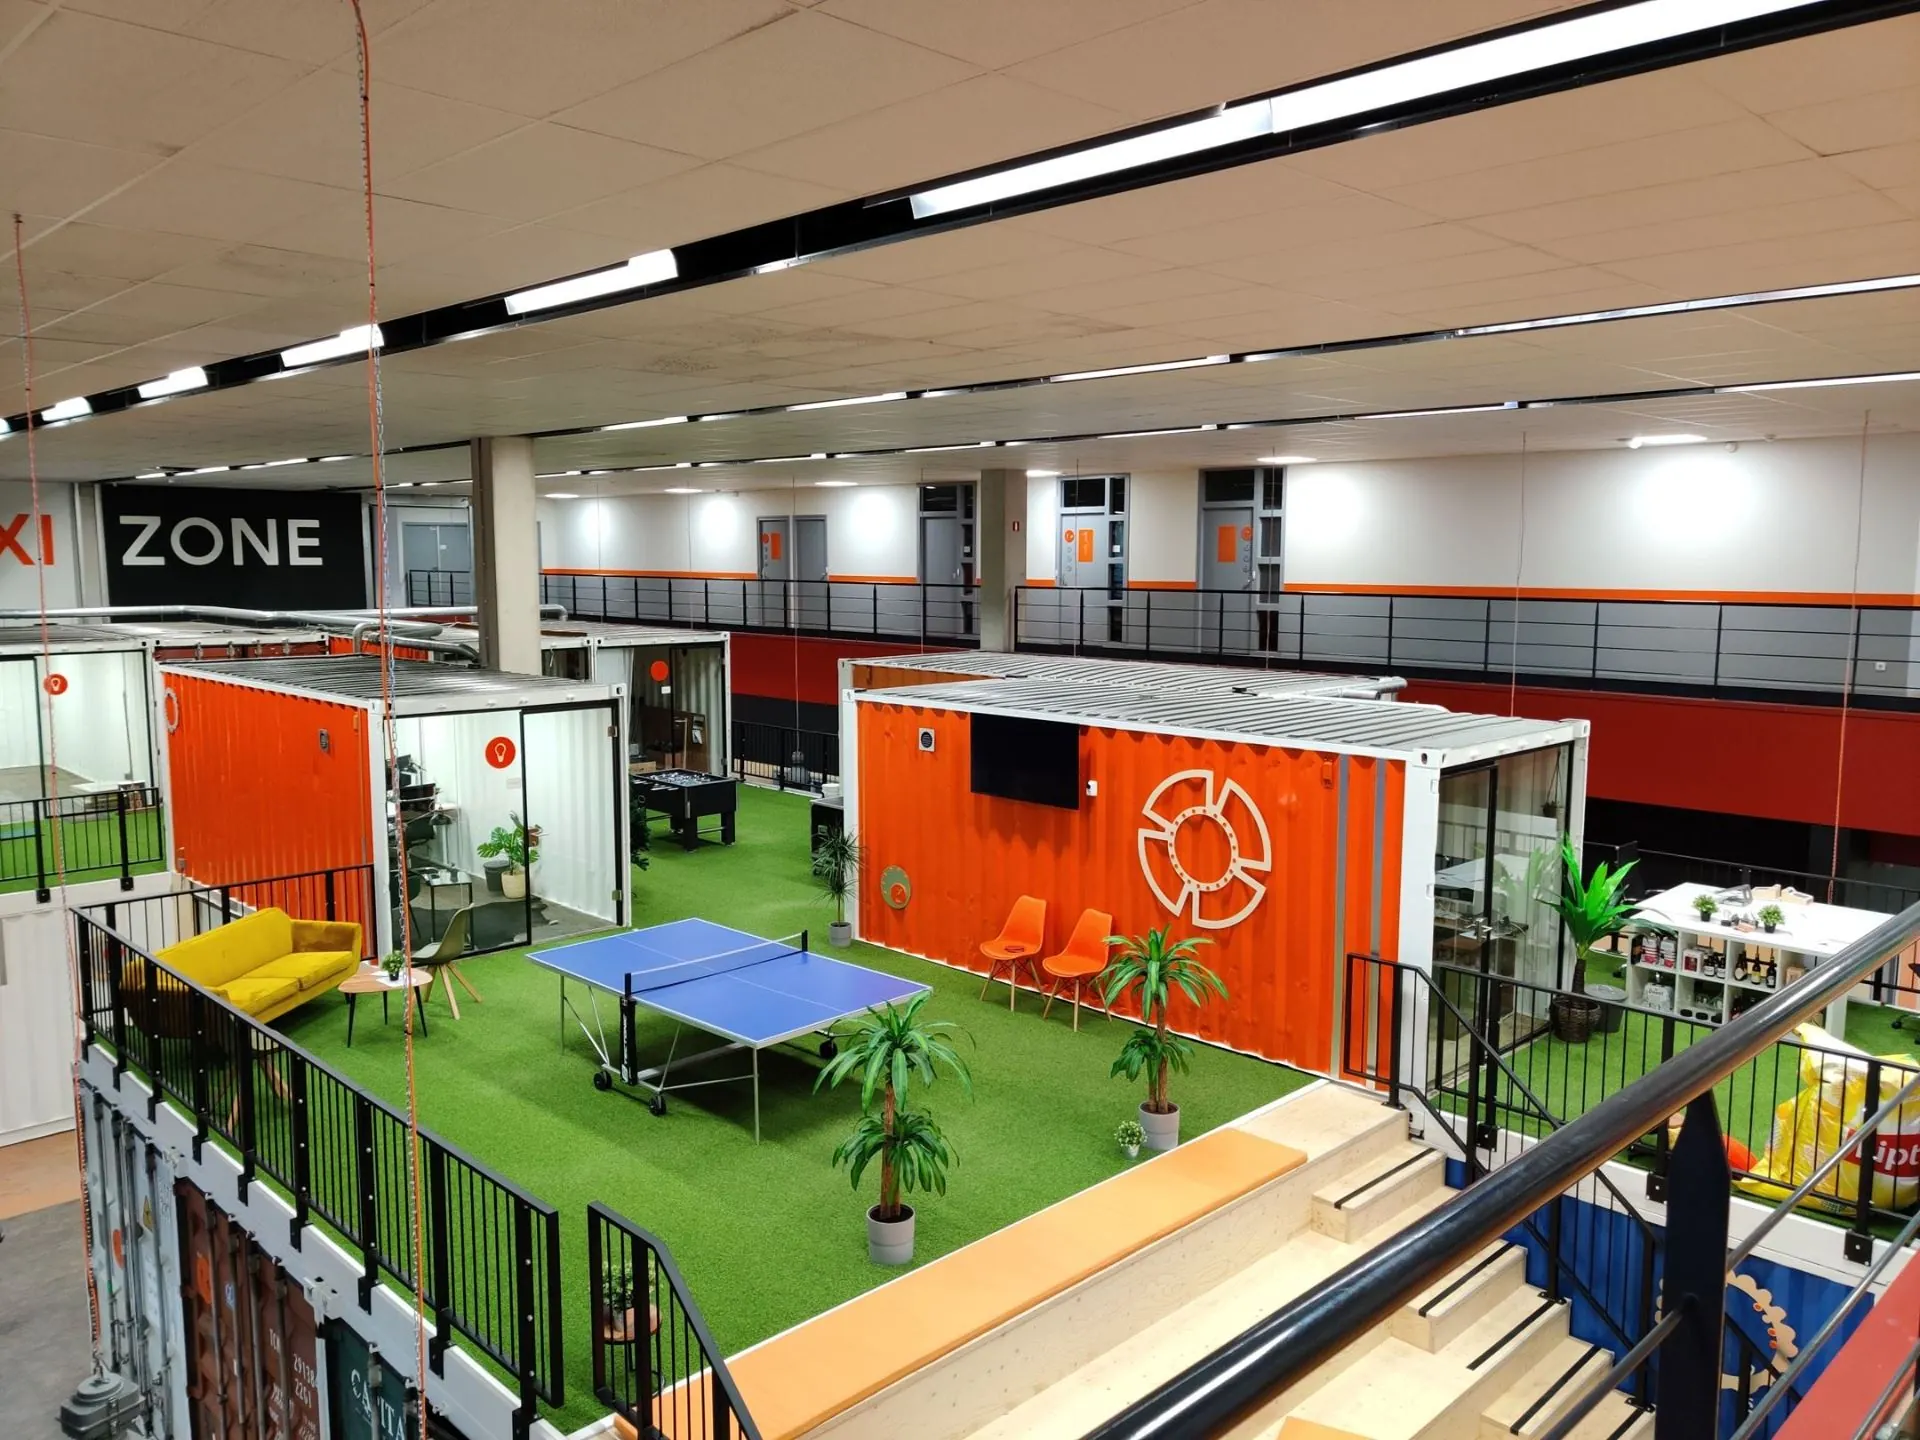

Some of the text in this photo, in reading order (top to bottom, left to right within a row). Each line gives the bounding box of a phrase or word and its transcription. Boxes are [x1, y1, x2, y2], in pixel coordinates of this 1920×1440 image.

[0, 513, 54, 566] XI
[119, 515, 323, 566] ZONE
[351, 1368, 406, 1440] CAITA
